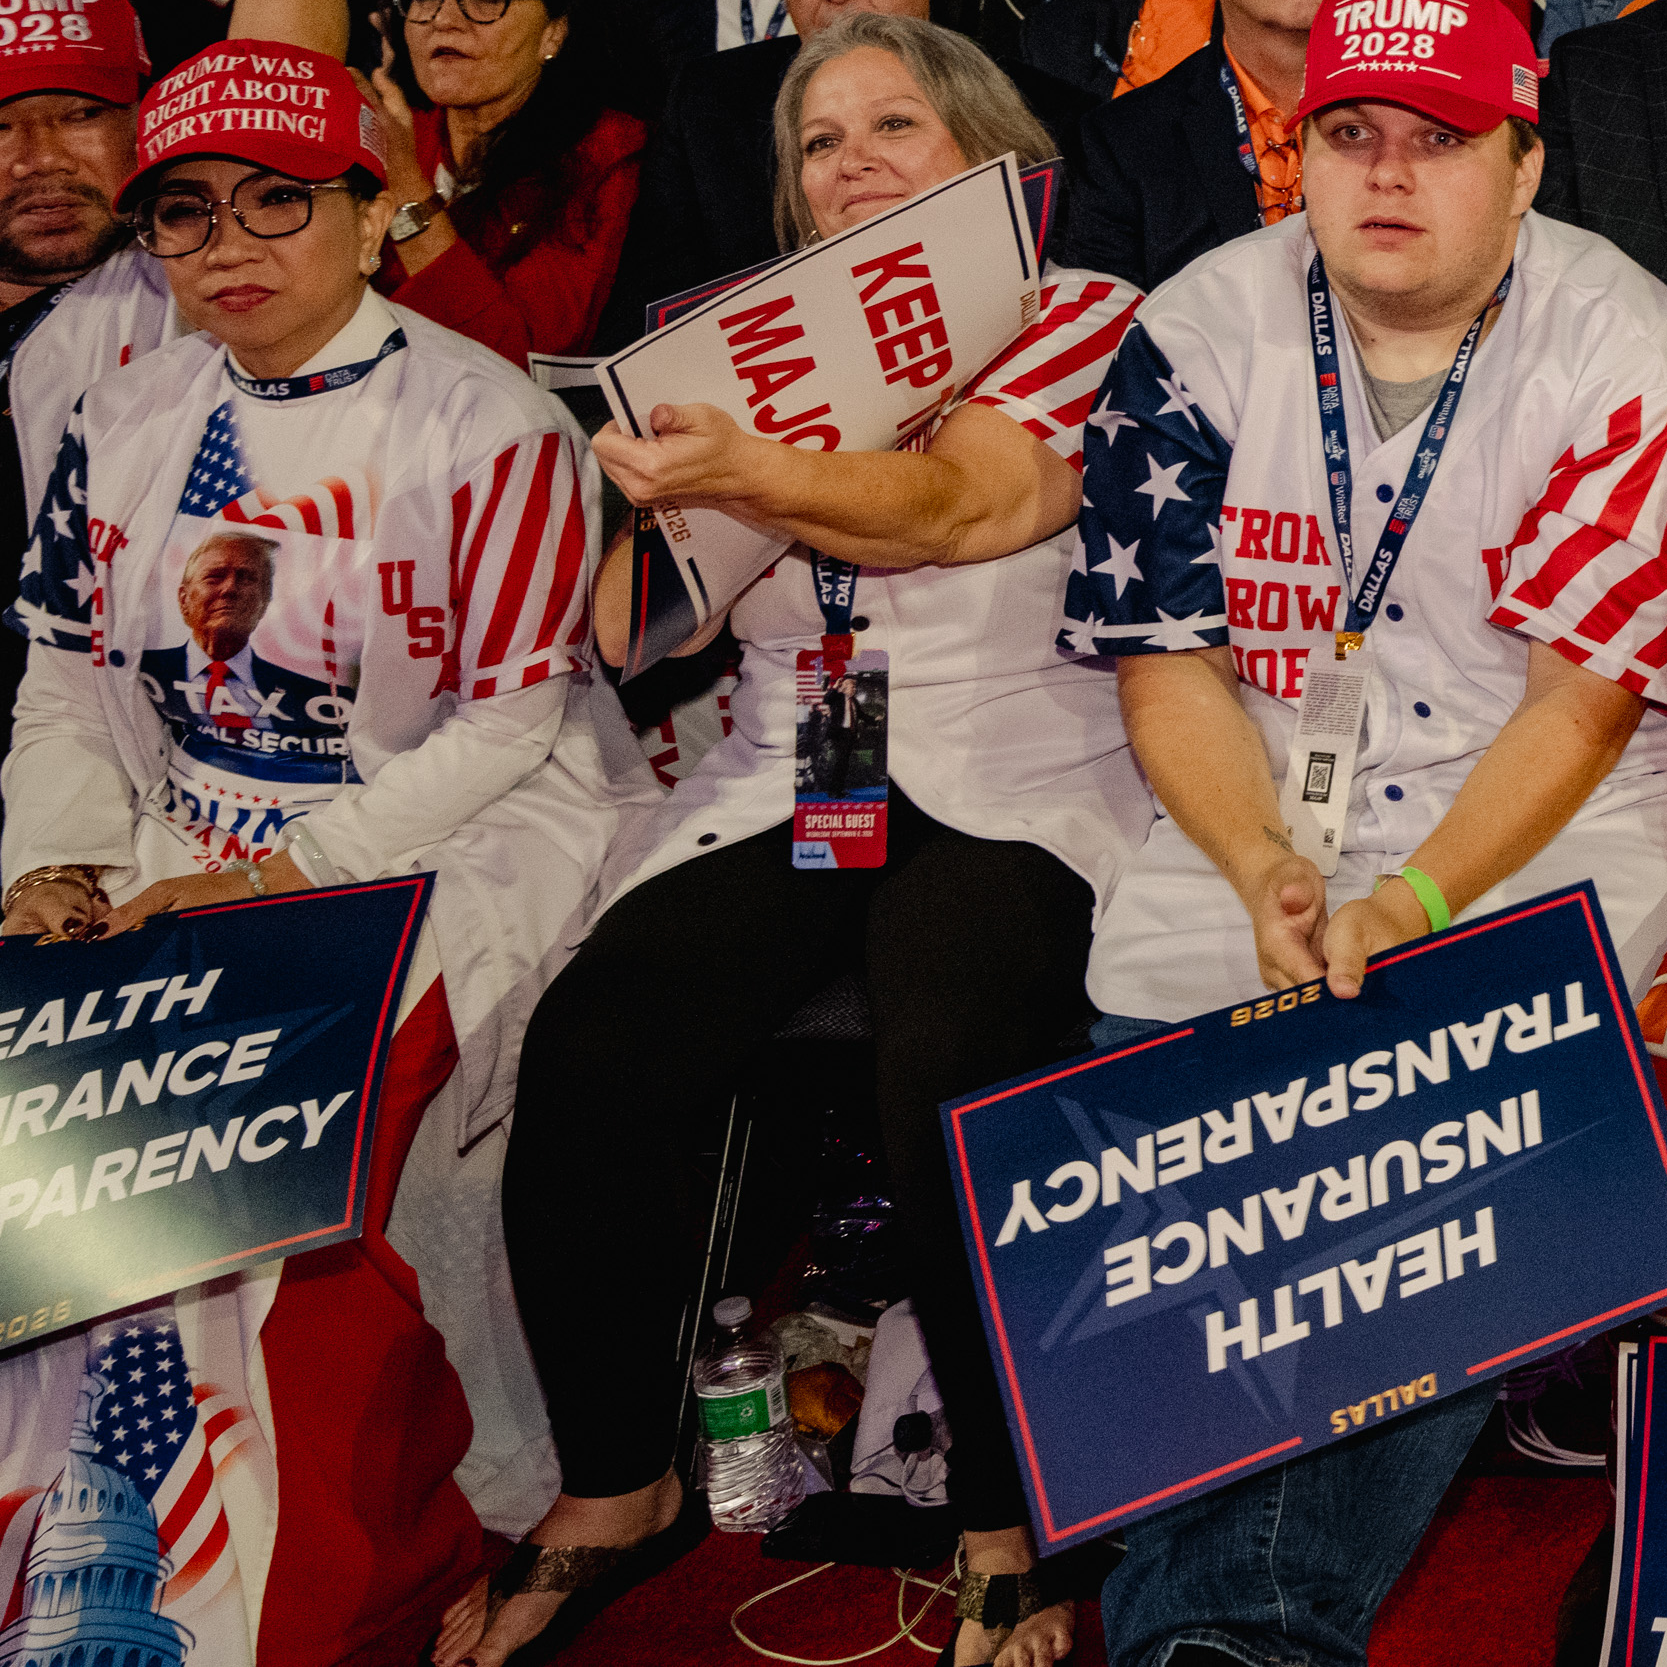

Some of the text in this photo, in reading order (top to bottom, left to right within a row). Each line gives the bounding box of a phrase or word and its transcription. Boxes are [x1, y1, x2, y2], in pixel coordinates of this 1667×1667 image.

[1333, 0, 1469, 36] TRUMP
[1341, 32, 1436, 60] 2028
[144, 78, 331, 131] RIGHT ABOUT
[158, 52, 315, 101] TRUMP WAS
[145, 107, 326, 162] EVERYTHING!
[852, 241, 953, 387] KEEP
[1312, 291, 1333, 355] DALLAS
[1450, 322, 1480, 383] DALLAS
[805, 814, 877, 830] SPECIAL GUEST
[1230, 984, 1322, 1027] 2026
[995, 982, 1599, 1246] TRANSPARENCY
[0, 1091, 356, 1232] PARENCY
[1105, 1091, 1542, 1308] INSURANCE
[1206, 1207, 1498, 1373] HEALTH
[1331, 1373, 1438, 1433] DALLAS
